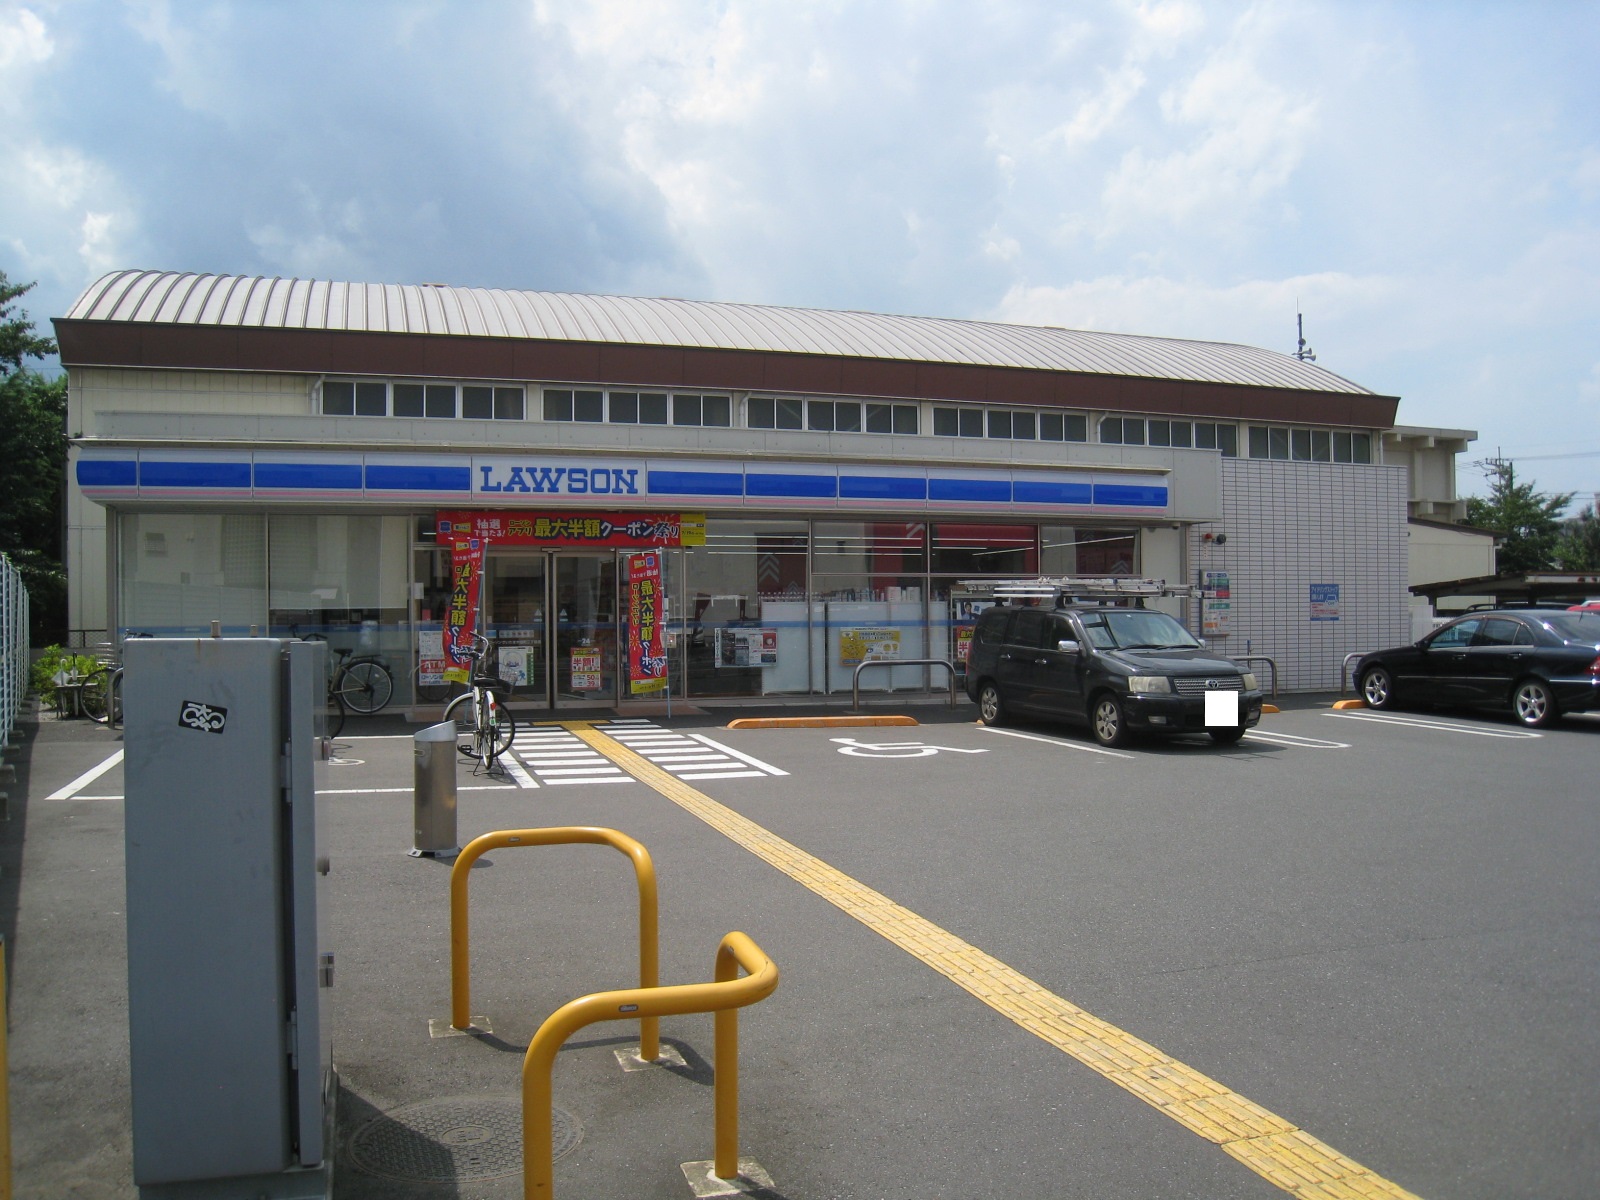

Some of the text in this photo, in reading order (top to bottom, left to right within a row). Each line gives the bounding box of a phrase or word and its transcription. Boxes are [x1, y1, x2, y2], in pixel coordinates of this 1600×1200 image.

[480, 466, 638, 493] LAWSON
[507, 526, 533, 537] アプリ
[534, 518, 679, 539] 最大半額クーポン祭り
[423, 660, 446, 669] ATM
